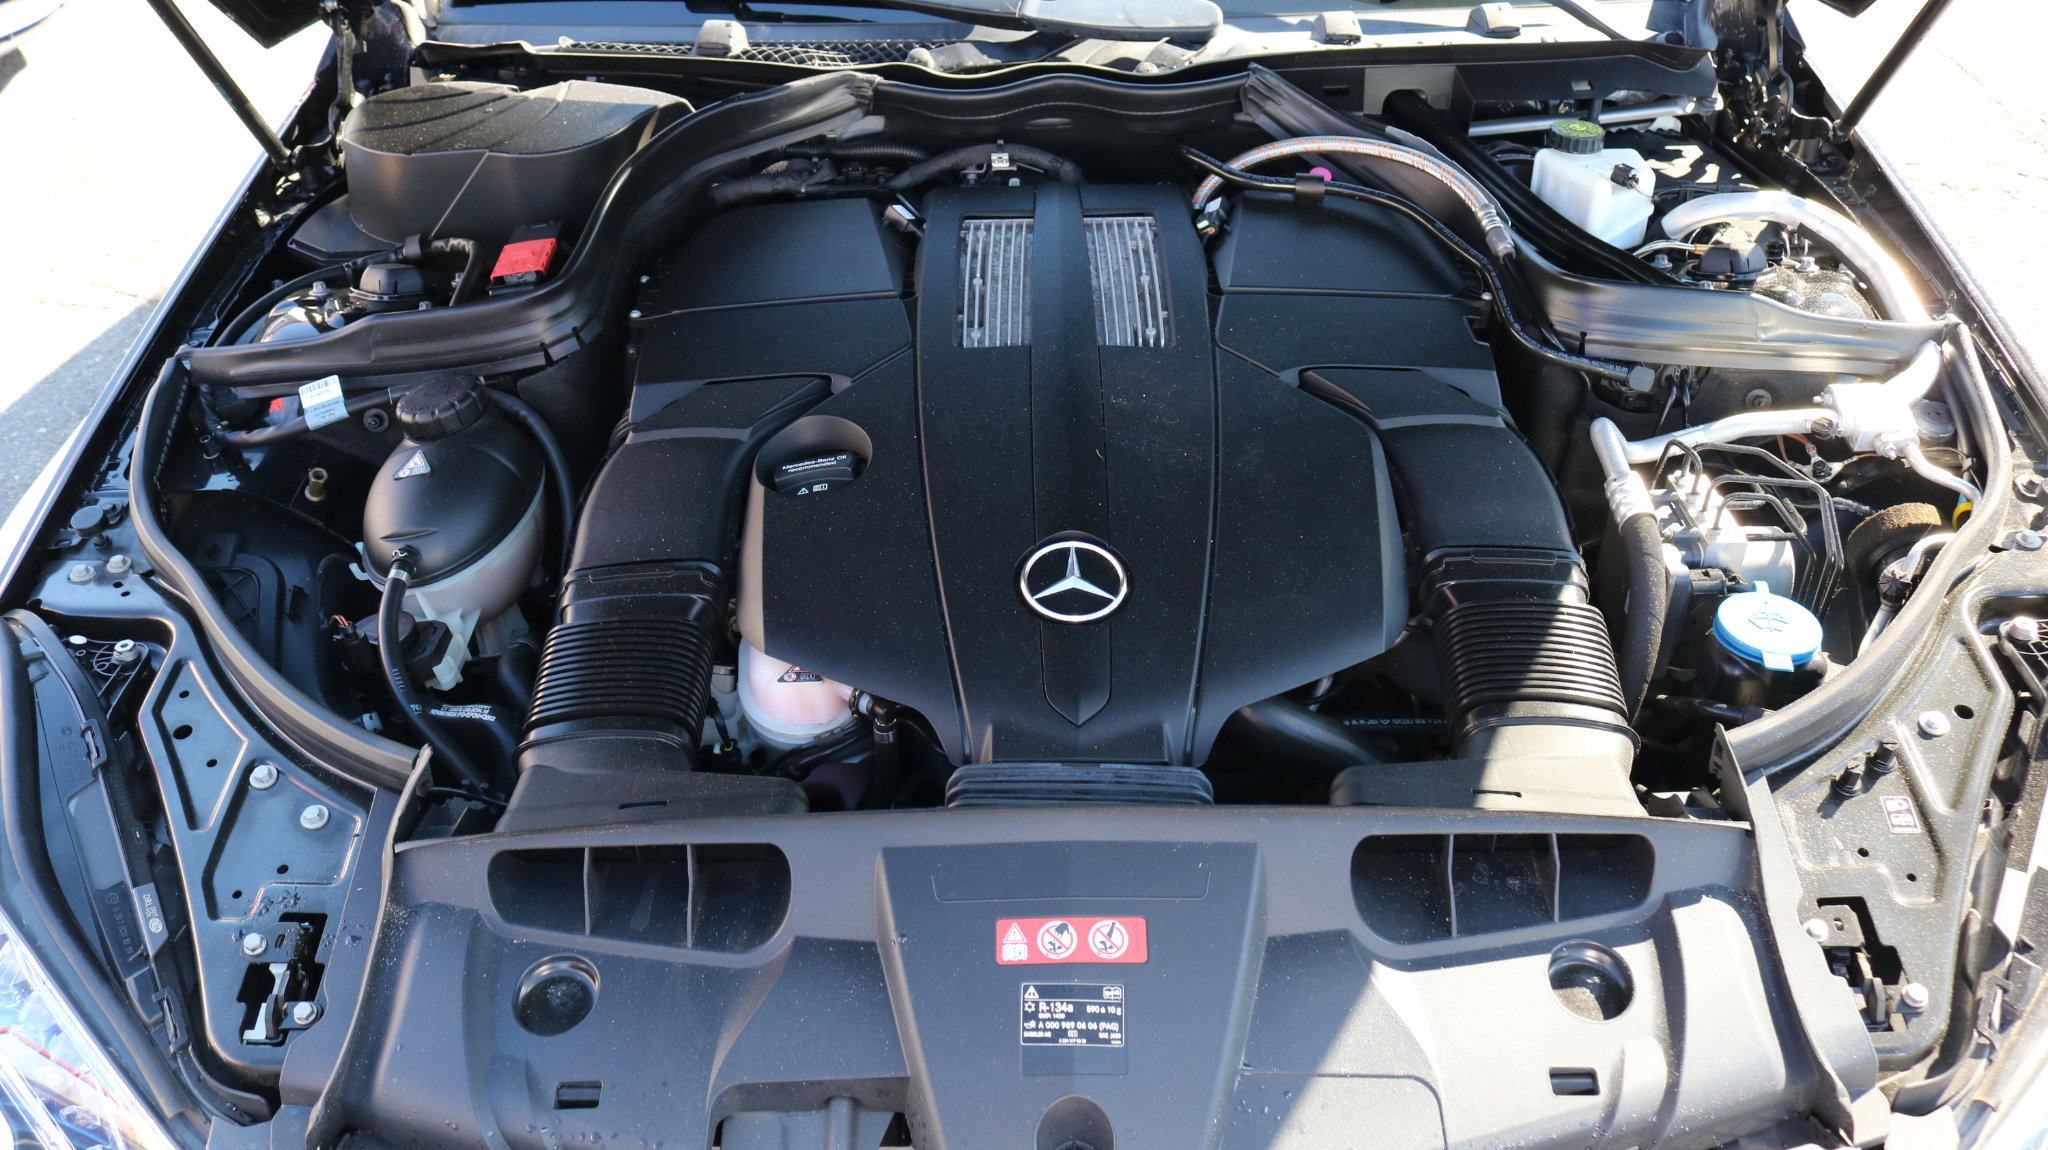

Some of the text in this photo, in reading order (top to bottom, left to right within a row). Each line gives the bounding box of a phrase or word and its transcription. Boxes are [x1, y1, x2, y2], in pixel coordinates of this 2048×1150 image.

[782, 457, 835, 470] Mercedes-Benz
[787, 460, 837, 473] recommended
[143, 893, 152, 907] DRL
[1039, 1002, 1074, 1013] R-134a
[1107, 1006, 1115, 1014] 10
[1116, 1007, 1122, 1016] g
[1038, 1021, 1119, 1032] A 000 989 06 06 (PAG)
